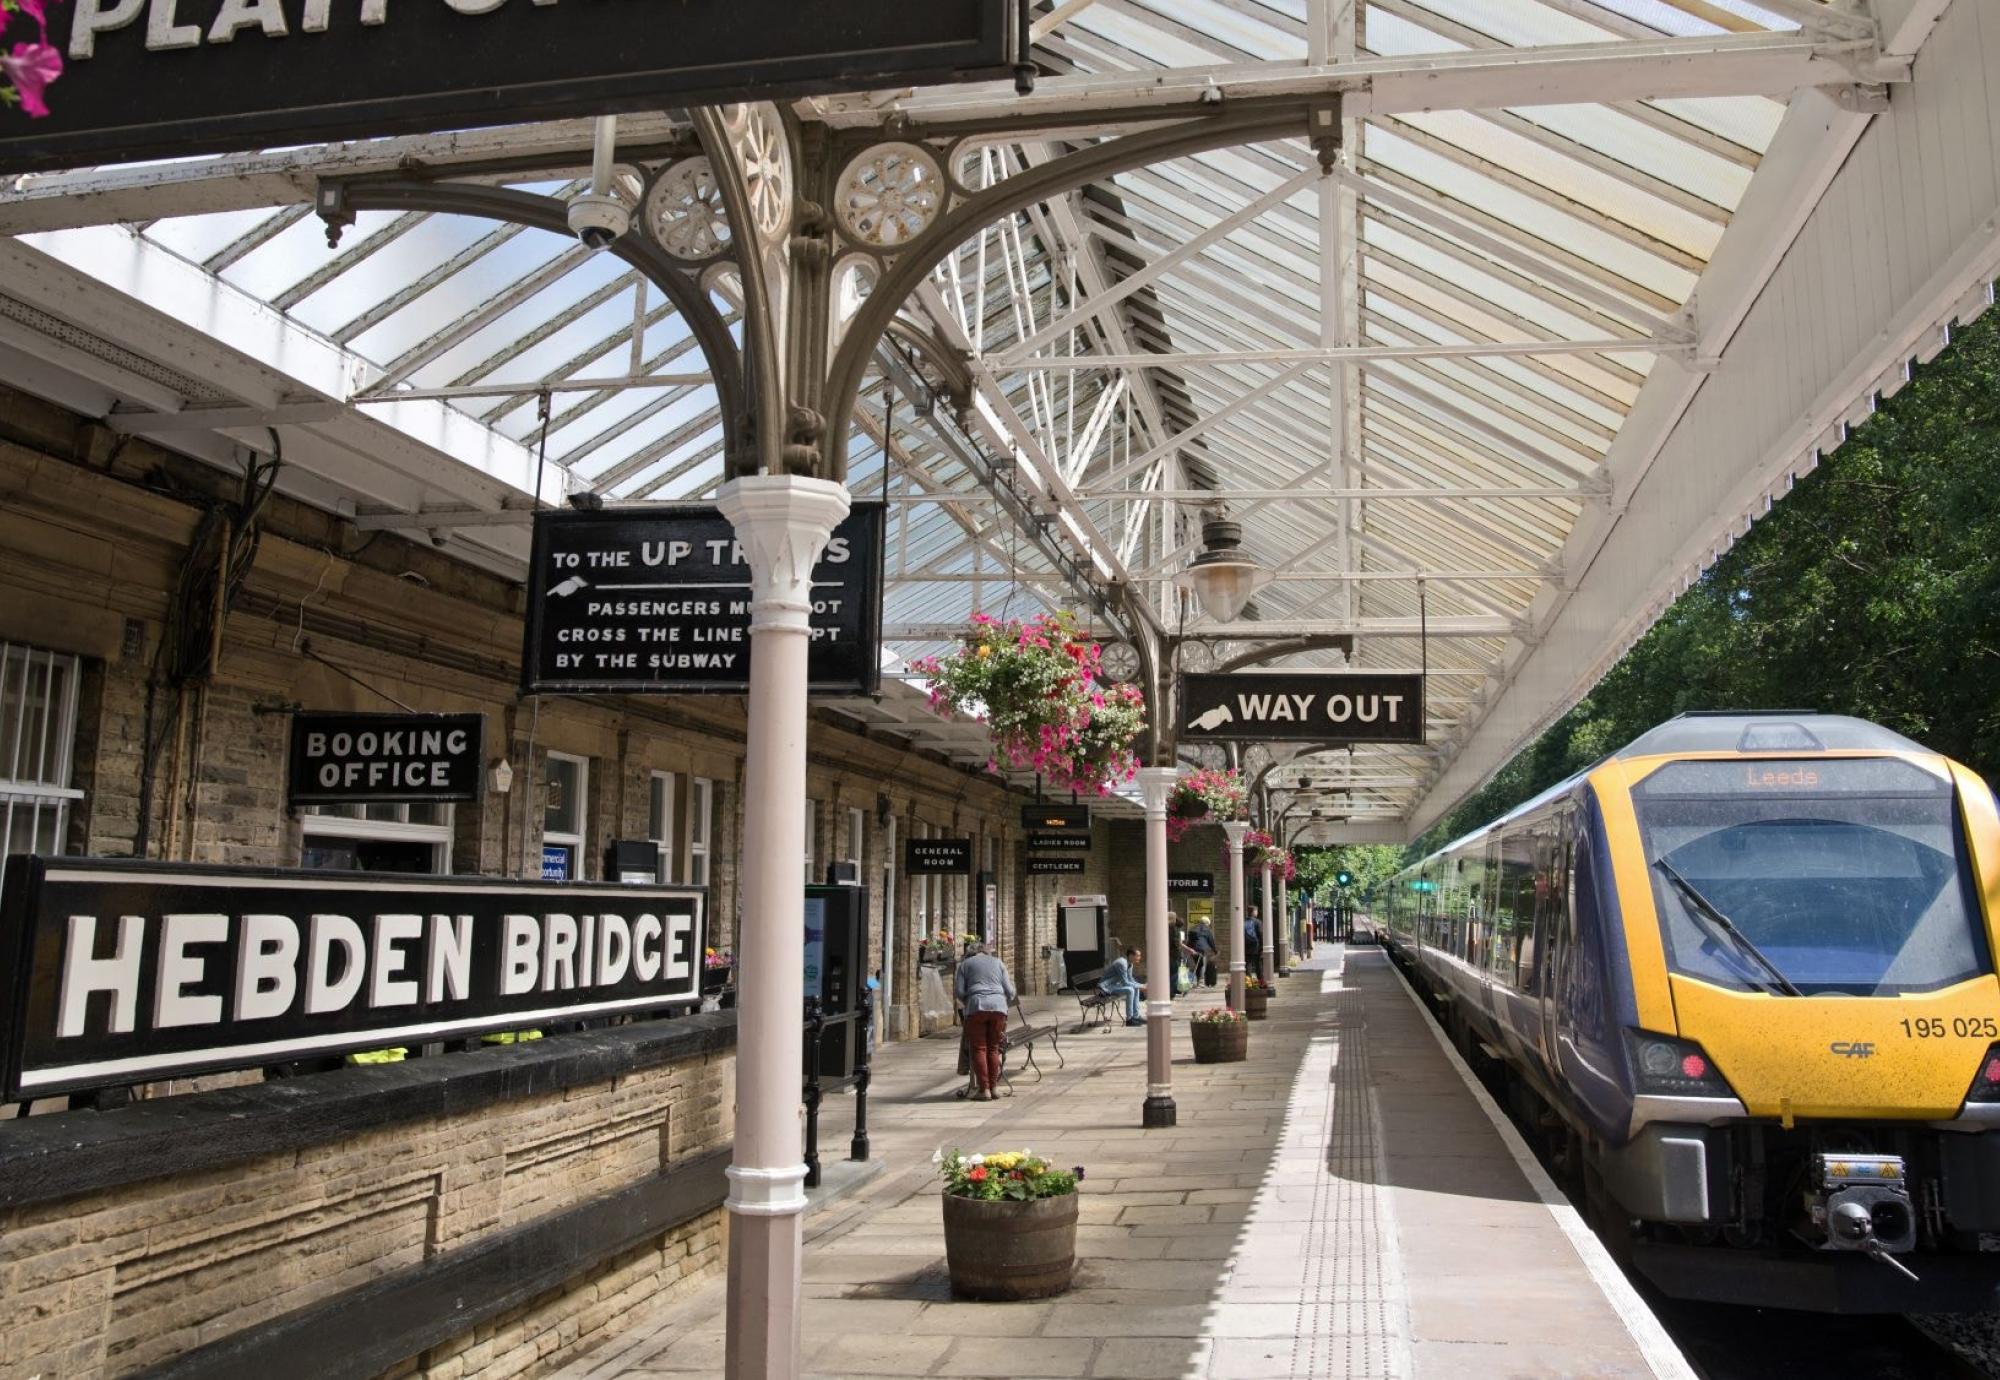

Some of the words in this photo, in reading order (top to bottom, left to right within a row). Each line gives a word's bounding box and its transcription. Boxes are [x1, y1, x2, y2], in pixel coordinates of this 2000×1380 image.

[552, 553, 580, 568] TO
[587, 551, 631, 567] THE
[641, 541, 692, 566] UP
[587, 602, 720, 616] PASSENGERS
[812, 600, 842, 614] OT
[557, 628, 626, 642] CROSS
[638, 628, 681, 642] THE
[693, 628, 743, 642] LINE
[556, 654, 584, 668] BY
[595, 654, 638, 668] THE
[648, 654, 736, 668] SUBWAY
[1237, 694, 1316, 722] WAY
[1326, 694, 1403, 723] OUT
[306, 730, 468, 758] BOOKING
[319, 761, 451, 788] OFFICE
[1747, 765, 1818, 786] Leeds
[914, 847, 963, 855] GENERAL
[1063, 839, 1086, 847] ROOM
[923, 858, 954, 866] ROOM
[1166, 879, 1199, 887] TFORM
[1202, 879, 1209, 887] 2
[57, 914, 474, 1038] HEBDEN
[500, 913, 691, 996] BRIDGE
[1900, 1018, 1946, 1038] 195
[1953, 1017, 1998, 1038] 025
[1830, 1041, 1875, 1058] CAF
